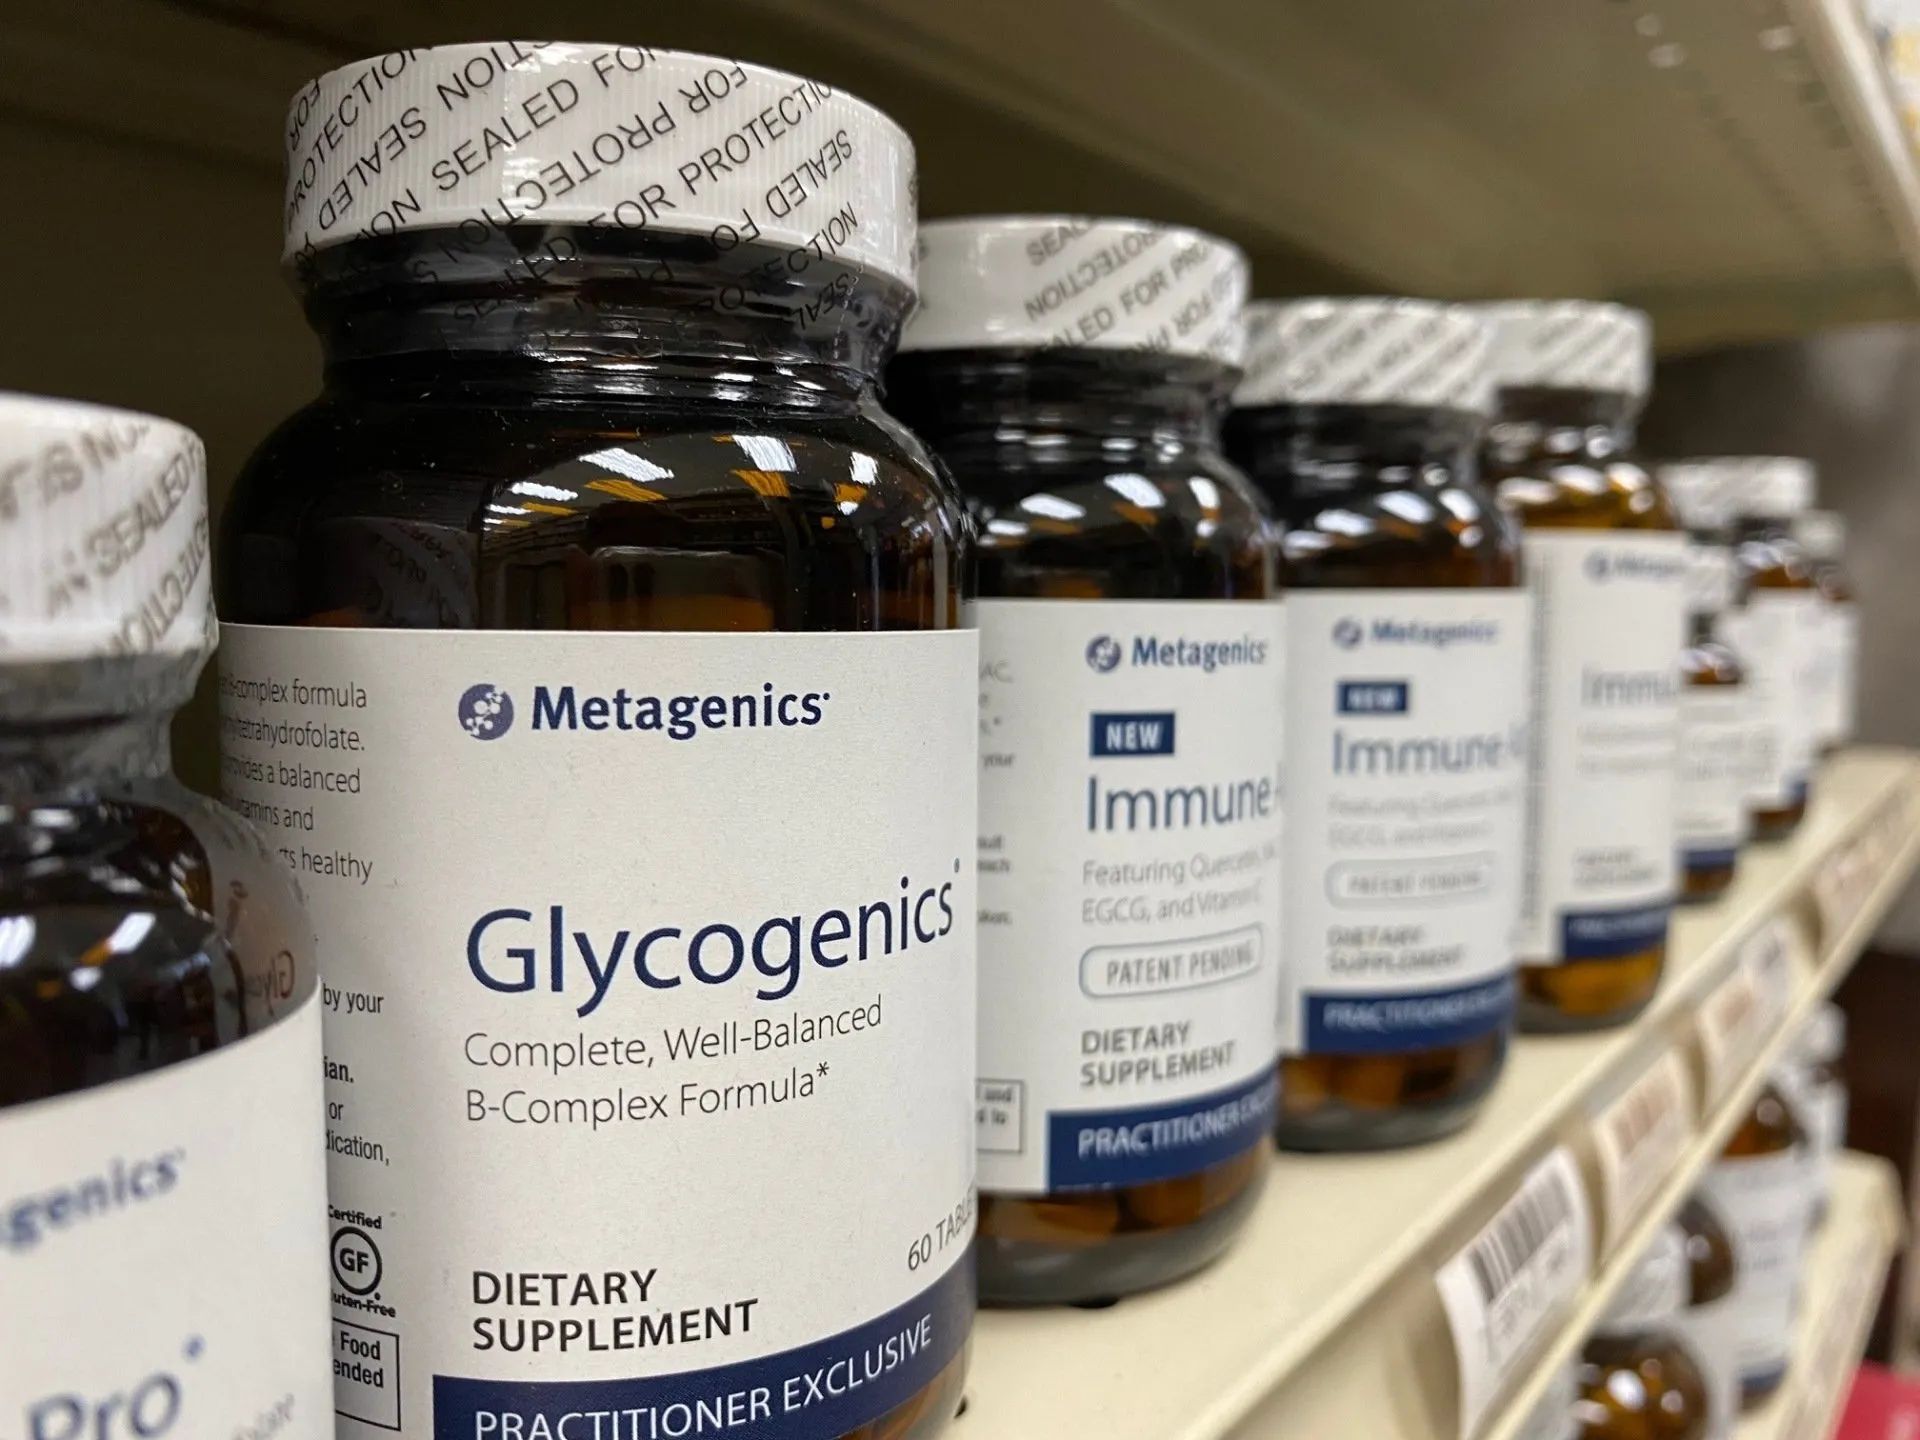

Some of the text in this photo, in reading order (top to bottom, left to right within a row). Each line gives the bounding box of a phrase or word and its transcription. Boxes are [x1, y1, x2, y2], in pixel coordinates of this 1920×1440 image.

[431, 78, 579, 191] SEALED
[319, 107, 427, 231] SEALED
[441, 66, 748, 263] FOR PROTECTION
[765, 130, 853, 218] SEALED
[588, 184, 676, 236] FOR
[1119, 267, 1168, 314] FOR
[1131, 634, 1268, 673] Metagenics
[293, 678, 367, 708] formula
[532, 682, 825, 742] Metagenics
[1106, 721, 1163, 751] NEW
[280, 760, 361, 794] balanced
[284, 806, 314, 831] and
[1087, 775, 1272, 832] Immune
[302, 846, 373, 885] healthy
[1082, 858, 1186, 886] Featuring
[1156, 891, 1194, 920] and
[466, 876, 953, 1019] Glycogenics
[1106, 954, 1182, 987] PATENT
[323, 983, 384, 1014] by your
[464, 993, 882, 1076] Complete, Well-Balanced
[1080, 1020, 1192, 1055] DIETARY
[1080, 1040, 1237, 1087] SUPPLEMENT
[329, 1101, 344, 1121] or
[466, 1087, 669, 1131] B-Complex
[1077, 1096, 1240, 1160] PRACTITIONER
[340, 1247, 369, 1274] GF
[908, 1233, 932, 1271] 60
[472, 1267, 658, 1307] DIETARY
[341, 1330, 381, 1360] Food
[472, 1297, 759, 1353] SUPPLEMENT
[475, 1314, 932, 1440] PRACTITIONER EXCLUSIVE
